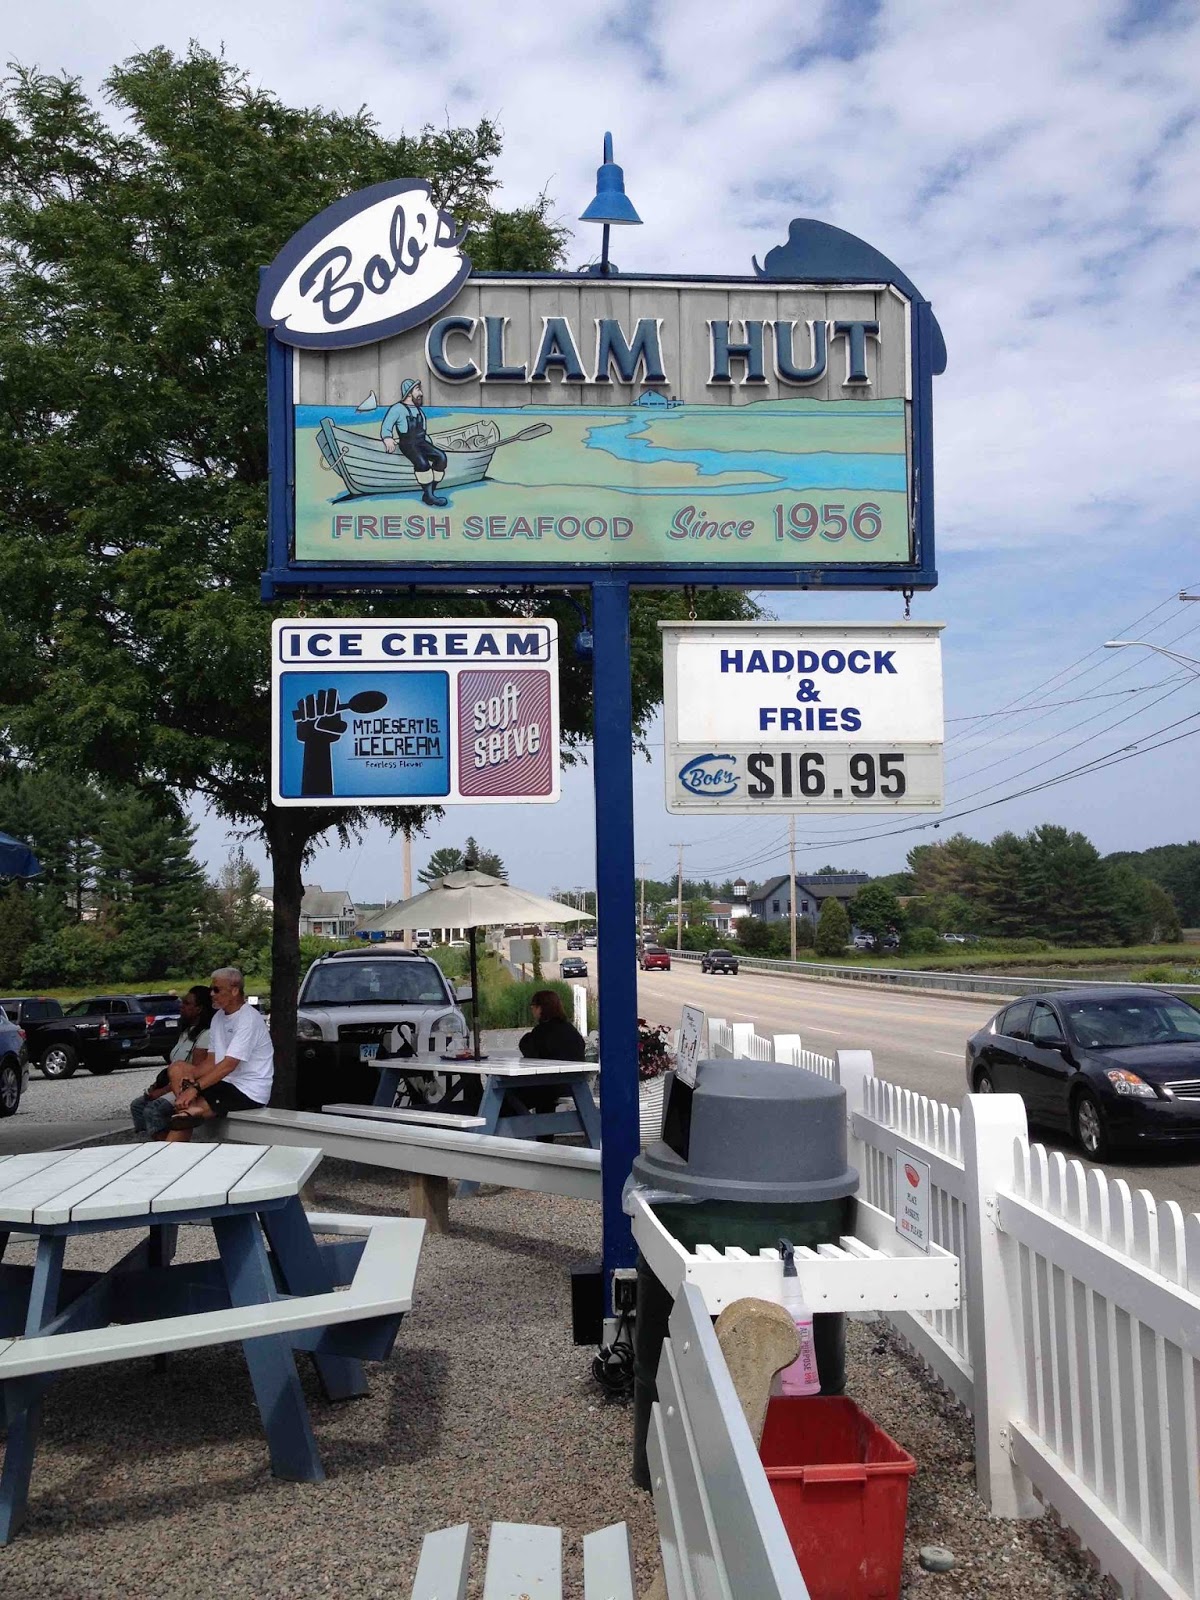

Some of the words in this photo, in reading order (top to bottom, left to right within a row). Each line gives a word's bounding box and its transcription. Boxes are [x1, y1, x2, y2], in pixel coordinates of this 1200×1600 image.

[299, 204, 468, 325] Bob's
[425, 315, 671, 385] CLAM
[706, 319, 882, 387] HUT
[332, 514, 451, 539] FRESH
[462, 514, 635, 541] SEAFOOD
[666, 504, 755, 541] Since
[773, 501, 883, 542] 1956
[290, 633, 363, 656] ICE
[381, 633, 540, 656] CREAM
[720, 649, 898, 674] HADDOCK
[796, 678, 822, 702] &
[474, 681, 521, 732] soft
[759, 707, 862, 731] FRIES
[474, 723, 540, 770] serve
[365, 760, 397, 769] Fearless
[399, 760, 424, 768] Flavor
[690, 767, 741, 787] Bob's
[747, 752, 907, 799] $16.95
[801, 1341, 811, 1371] PURPOSE
